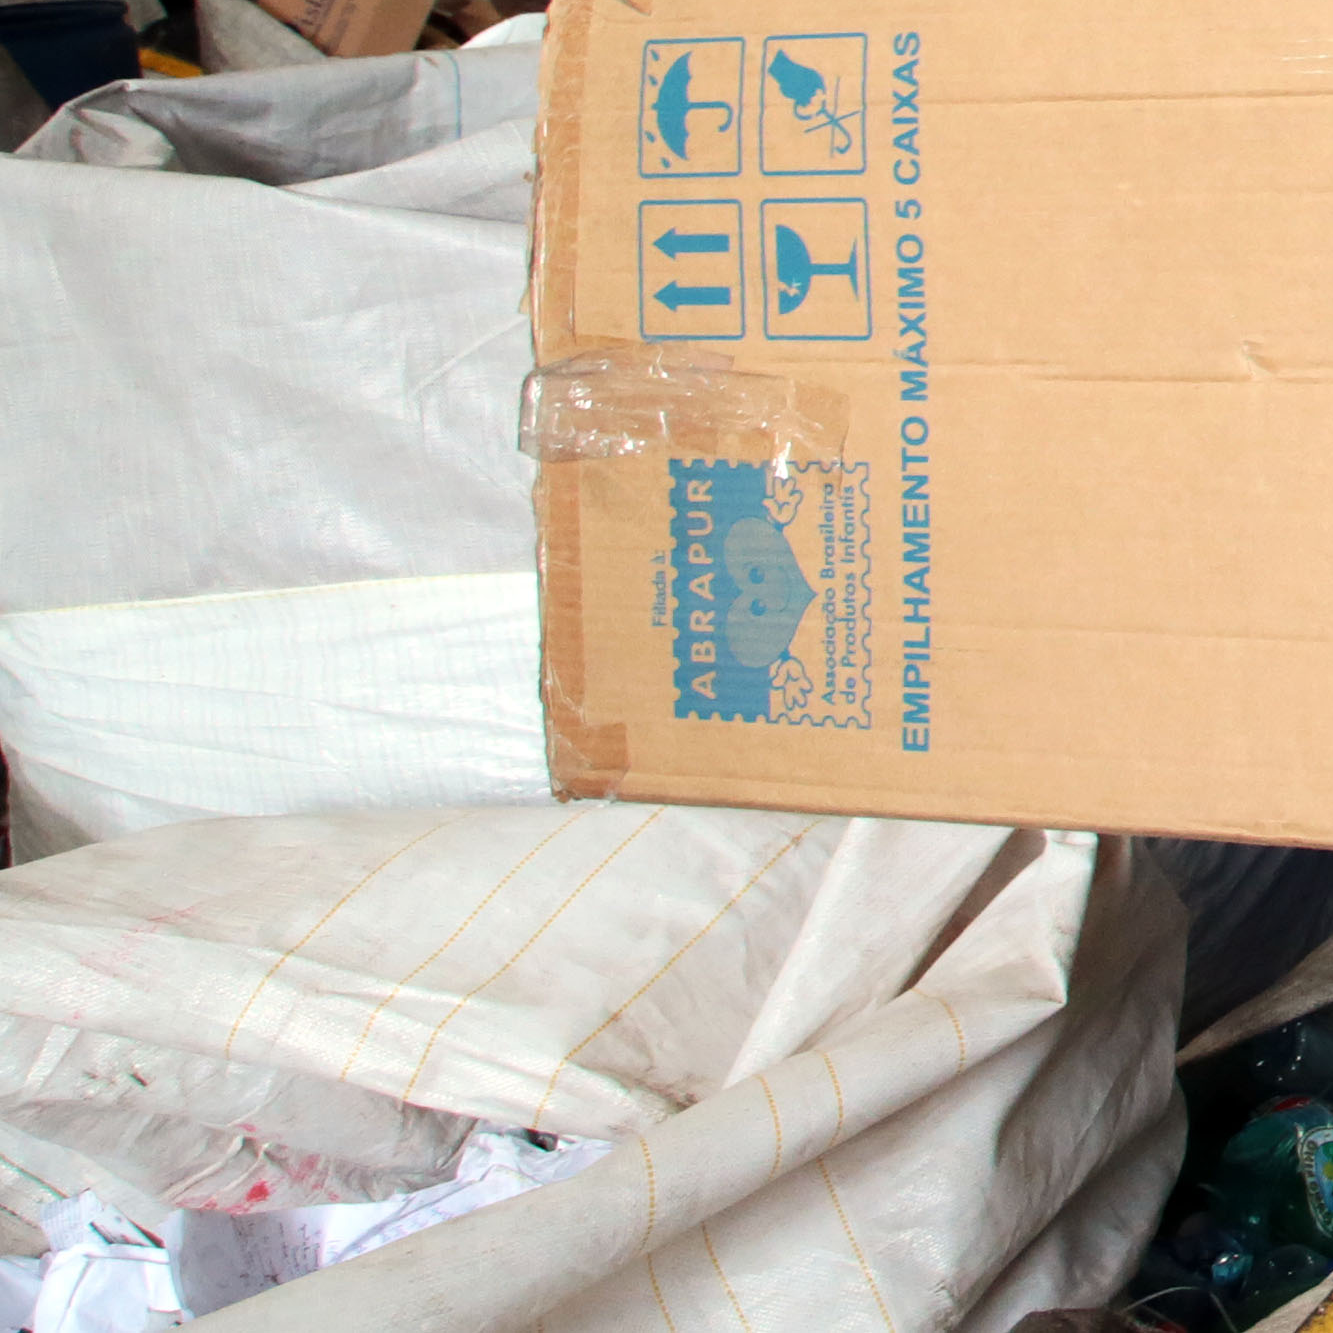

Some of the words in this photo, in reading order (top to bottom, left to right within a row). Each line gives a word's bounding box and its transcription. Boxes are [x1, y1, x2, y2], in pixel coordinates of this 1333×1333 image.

[892, 32, 920, 185] CAIXAS
[896, 200, 921, 218] 5
[893, 234, 928, 401] MÁXIMO
[820, 484, 834, 578] Brasileira
[839, 487, 854, 563] Infantis
[653, 572, 666, 626] Filiada
[686, 478, 716, 700] ABRAPUR
[837, 574, 856, 667] Produtos
[901, 417, 930, 752] EMPILHAMENTO
[822, 589, 842, 704] Associação
[840, 678, 856, 703] de
